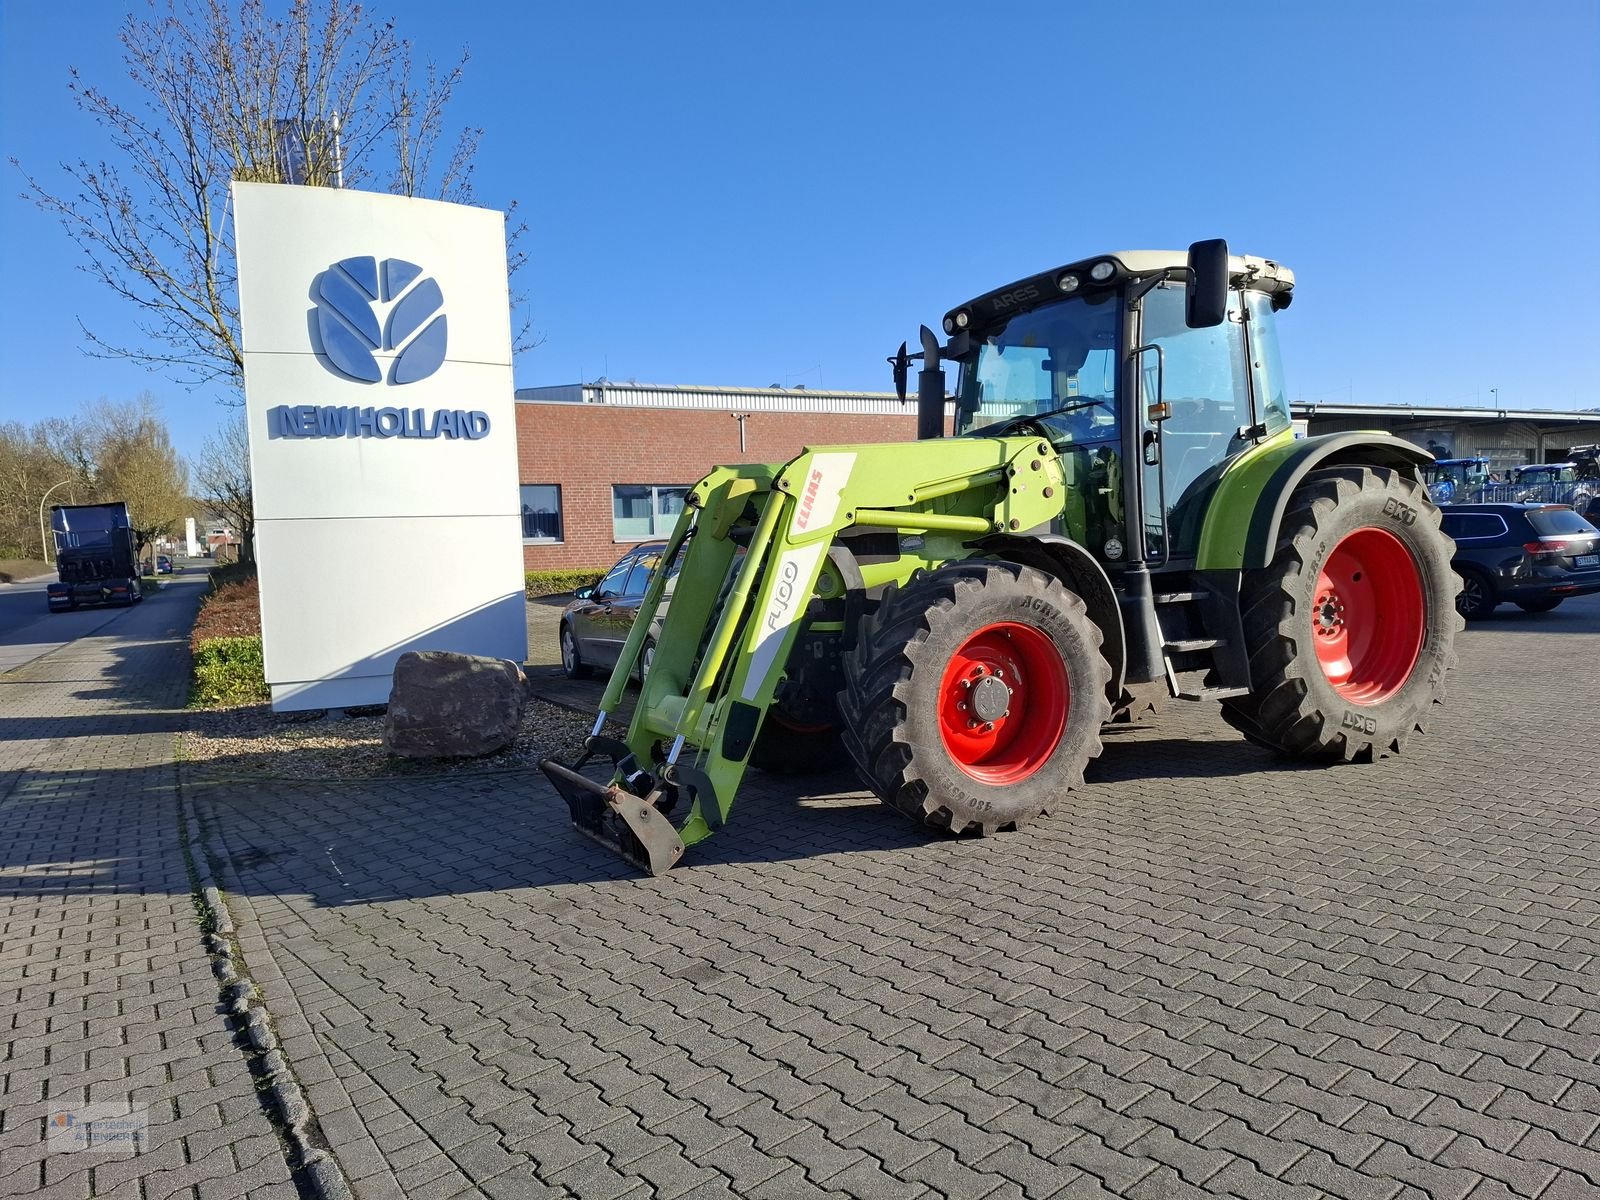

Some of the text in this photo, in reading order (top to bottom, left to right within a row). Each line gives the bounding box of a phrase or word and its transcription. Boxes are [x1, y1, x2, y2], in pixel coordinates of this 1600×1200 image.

[993, 284, 1040, 310] ARES
[270, 404, 491, 440] NEW HOLLAND
[796, 469, 823, 530] CLAAS
[1382, 496, 1418, 527] BKT
[1341, 709, 1377, 736] BKT
